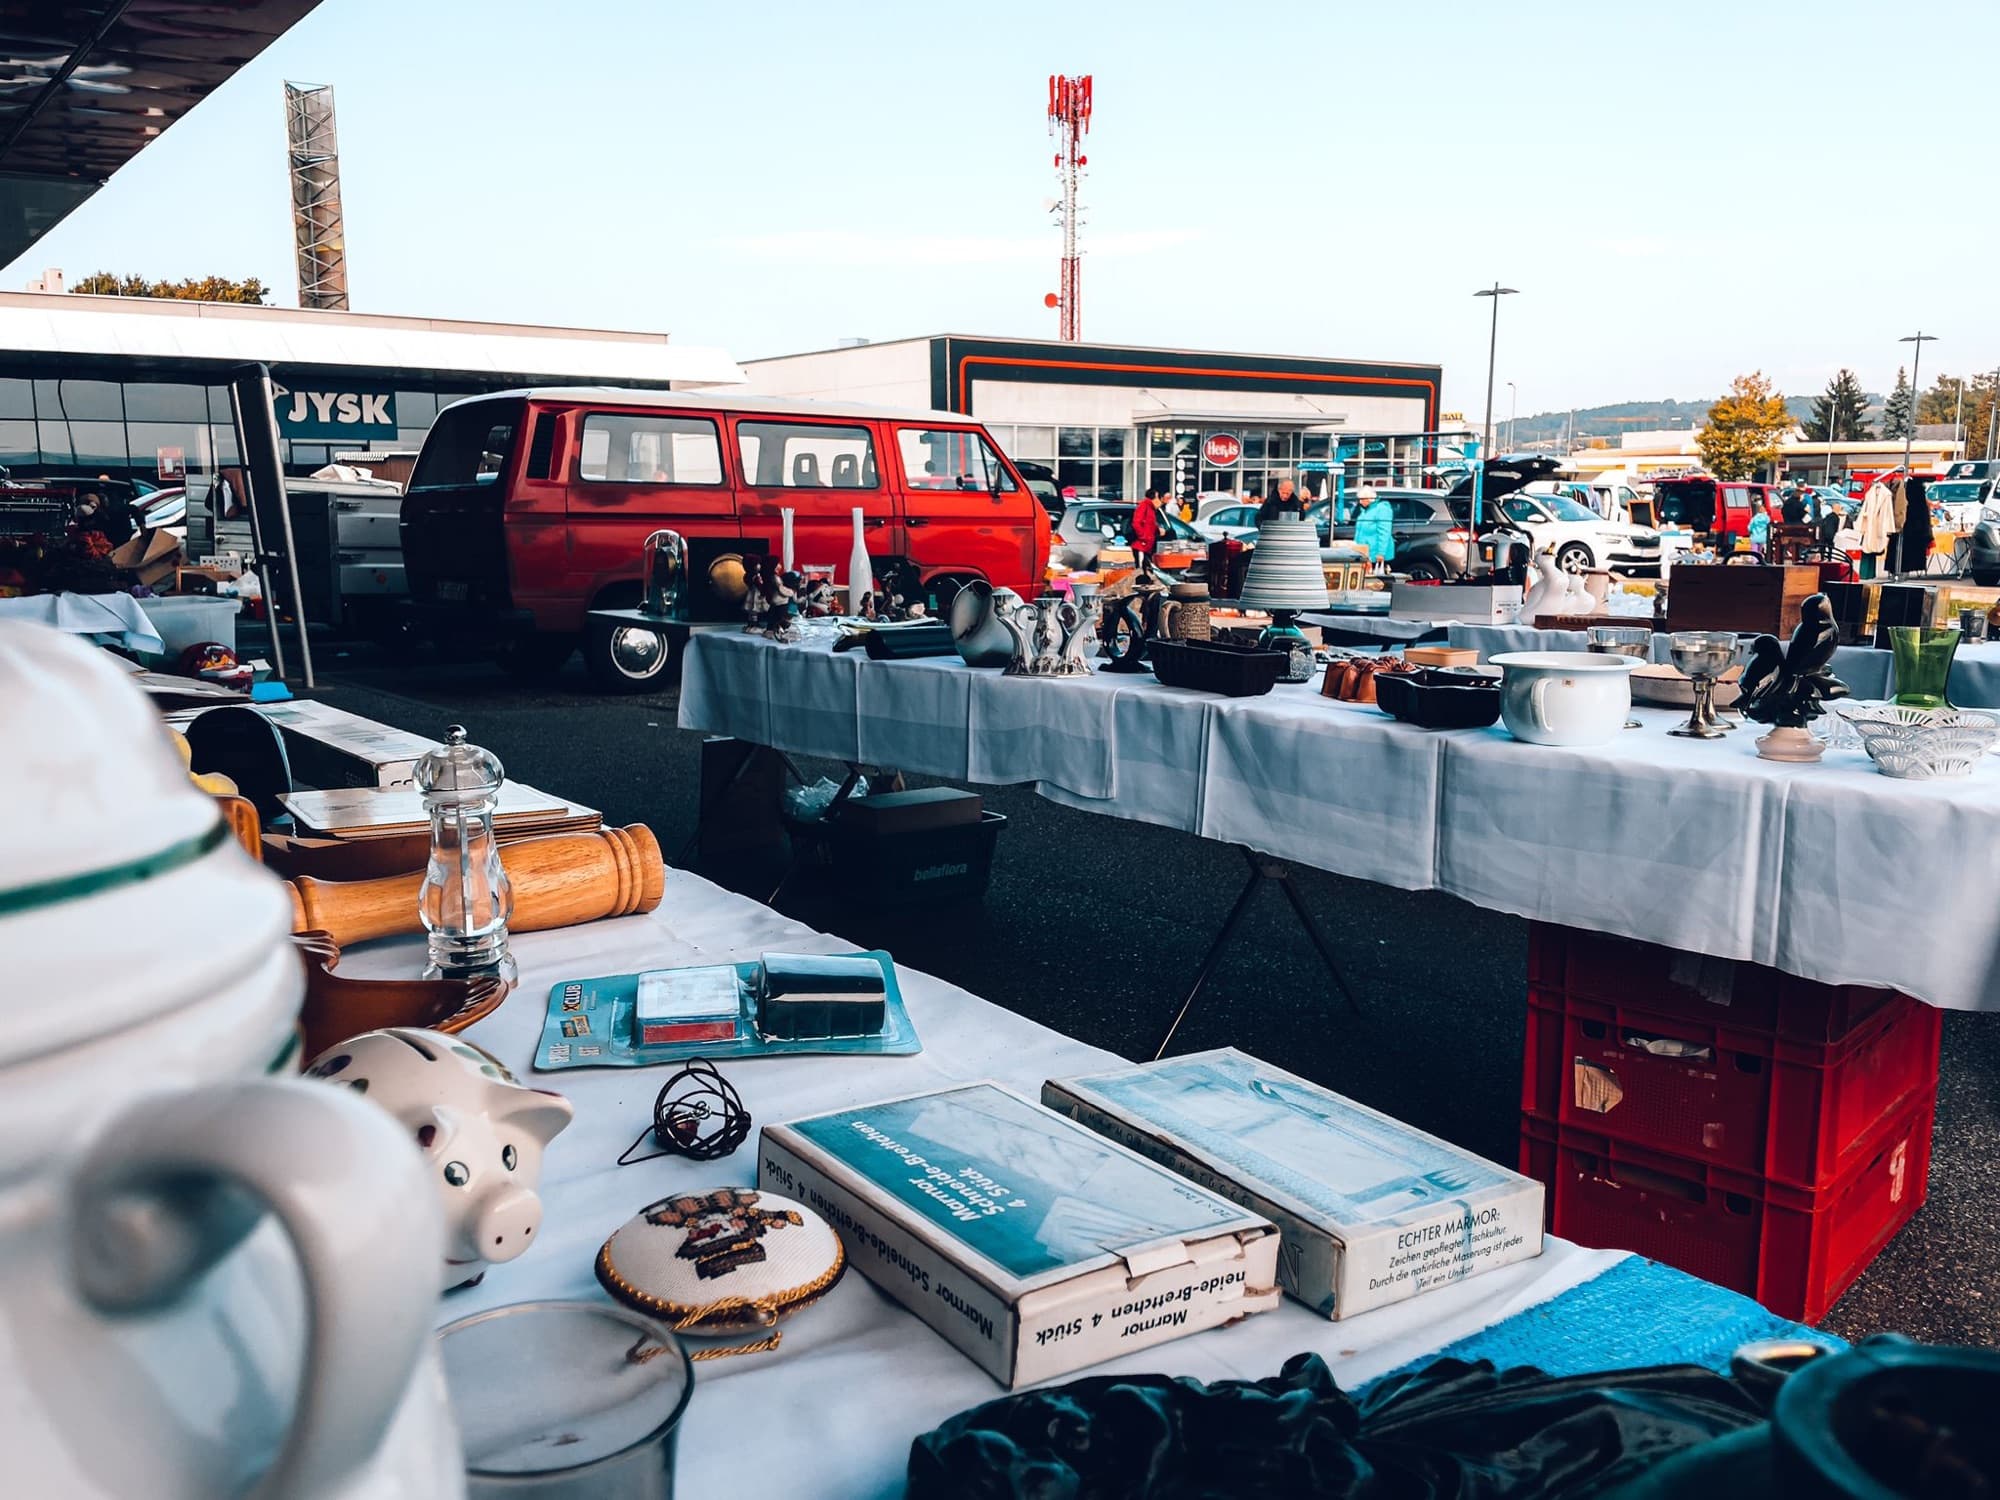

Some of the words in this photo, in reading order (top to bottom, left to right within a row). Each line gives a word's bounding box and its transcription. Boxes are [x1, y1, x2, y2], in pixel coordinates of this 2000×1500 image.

[288, 391, 392, 425] JYSK
[765, 1157, 794, 1191] Stück
[851, 1120, 1006, 1216] Schneide-Brettchen
[958, 1166, 1011, 1198] Stück
[797, 1181, 806, 1199] 4
[909, 1177, 982, 1222] Marmor
[1006, 1198, 1028, 1208] 4
[809, 1188, 930, 1293] Schneide-Brettchen
[1397, 1224, 1442, 1251] ECHTER
[1444, 1207, 1501, 1236] MARMOR:
[1368, 1273, 1395, 1291] Durch
[1395, 1270, 1409, 1282] die
[1410, 1257, 1451, 1277] natürliche
[1451, 1245, 1492, 1266] Maserung
[1492, 1240, 1503, 1252] ist
[1502, 1234, 1524, 1252] jedes
[1388, 1251, 1421, 1269] Zeichen
[1422, 1239, 1465, 1261] gepflegter
[1433, 1272, 1446, 1284] ein
[1447, 1263, 1475, 1280] Unikat
[935, 1282, 994, 1341] Marmor
[1090, 1312, 1103, 1329] 4
[1120, 1308, 1188, 1338] Marmor
[1035, 1318, 1083, 1346] Stück
